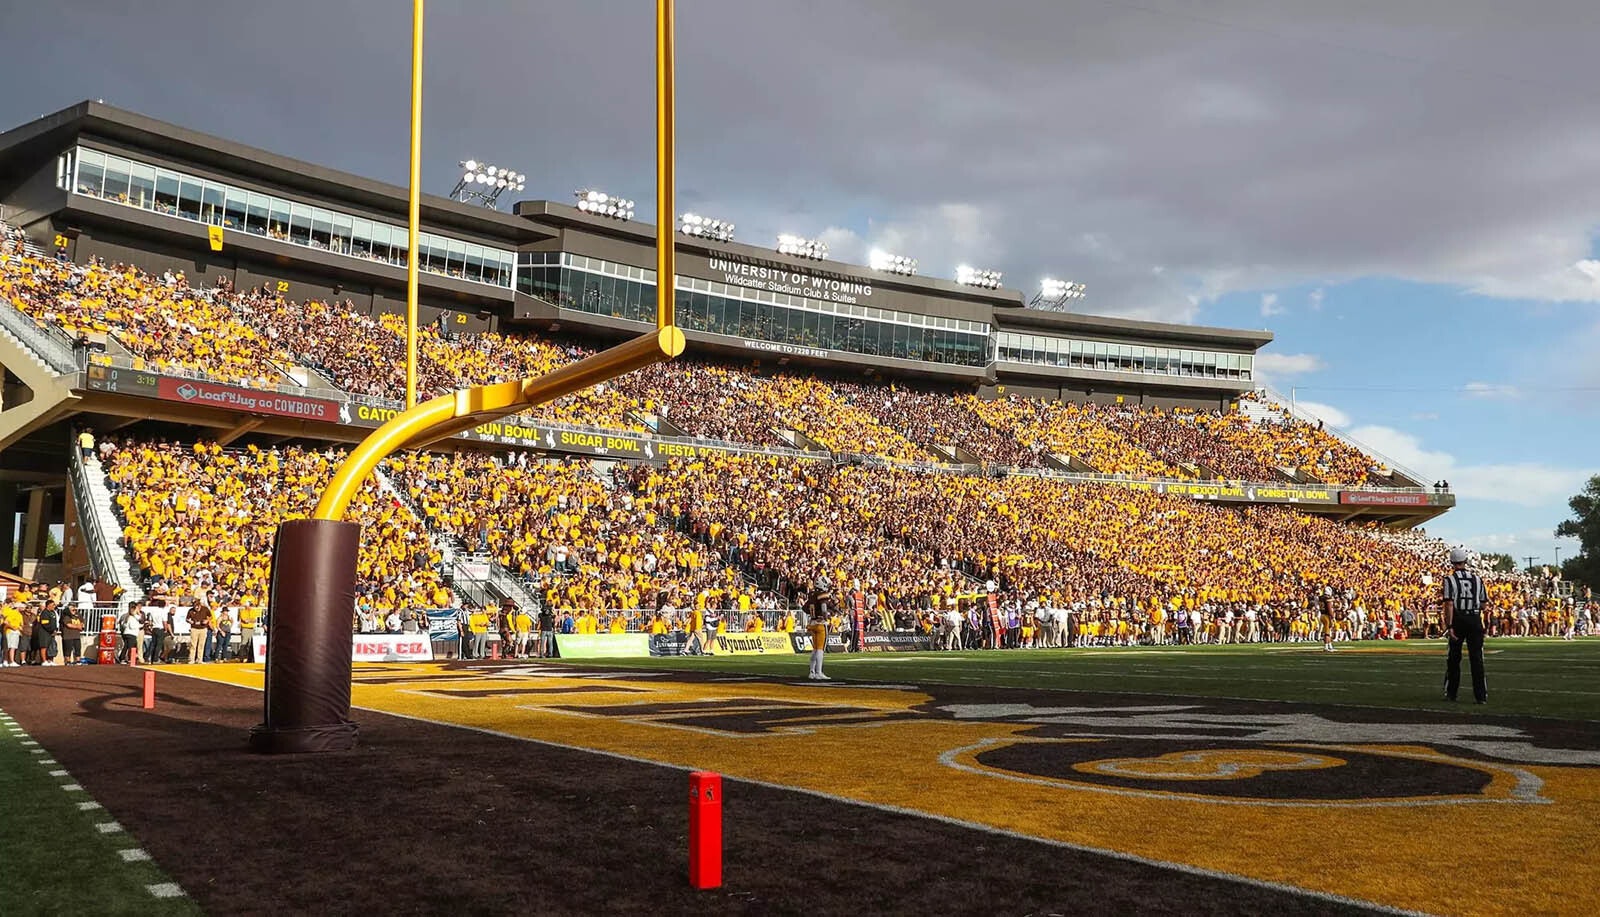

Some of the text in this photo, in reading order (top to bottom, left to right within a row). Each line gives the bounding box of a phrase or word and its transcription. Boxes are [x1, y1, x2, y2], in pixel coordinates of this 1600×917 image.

[54, 234, 68, 248] 21
[710, 258, 873, 297] UNIVERSITY OF WYOMING
[277, 281, 289, 293] 22
[725, 273, 857, 306] Wildcatter Stadium Club & Suites
[456, 314, 468, 325] 23
[744, 340, 782, 353] WELCOME
[782, 345, 793, 355] TO
[811, 349, 829, 359] FEET
[111, 370, 118, 380] 0
[136, 374, 156, 386] 3:19
[106, 381, 117, 391] 14
[275, 398, 325, 416] COWBOYS
[504, 424, 541, 441] BOWL
[561, 432, 641, 452] SUGAR BOWL
[658, 443, 696, 458] FIESTA
[1167, 484, 1186, 494] NEW
[1188, 485, 1219, 496] MEXICO
[1220, 486, 1245, 497] BOWL
[1257, 488, 1330, 500] POINSETTIA BOWL
[1459, 579, 1473, 598] R
[353, 642, 391, 655] IRE
[717, 635, 763, 653] Wyoming
[795, 636, 815, 652] CA
